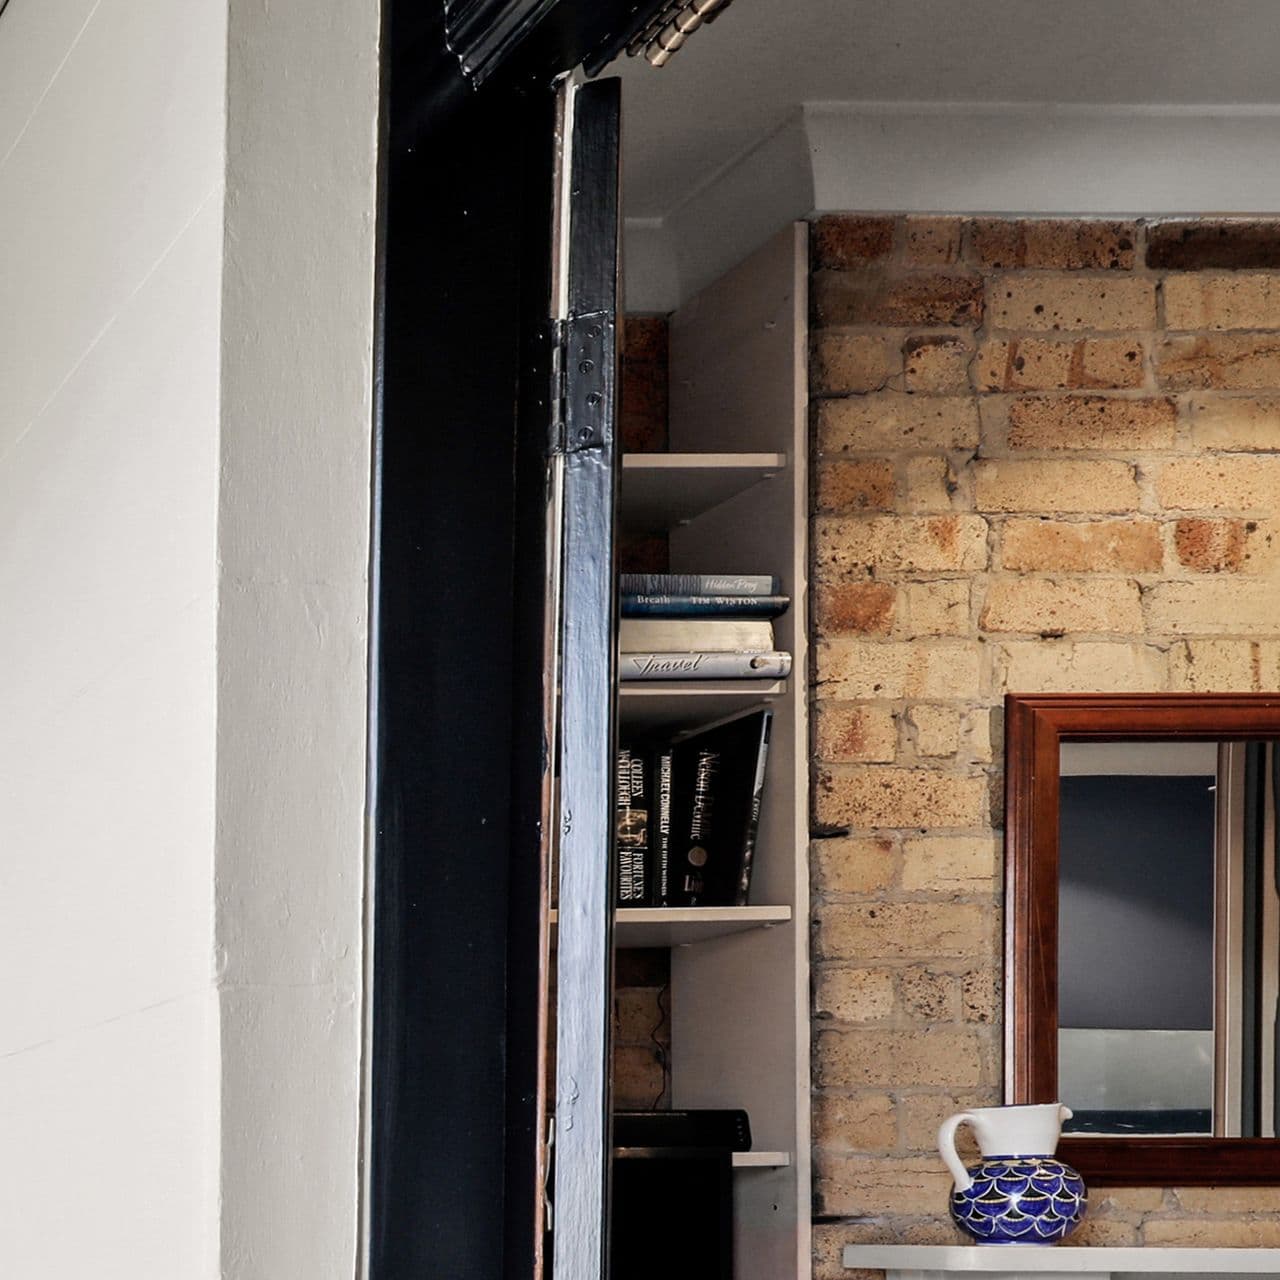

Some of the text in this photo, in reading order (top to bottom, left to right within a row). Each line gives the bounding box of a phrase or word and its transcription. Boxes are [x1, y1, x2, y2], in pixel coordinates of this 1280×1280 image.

[637, 594, 671, 605] Breath
[691, 597, 710, 605] TIM
[633, 654, 703, 677] Travel
[631, 758, 644, 797] COLLEEN
[661, 756, 671, 792] MICHAEL
[695, 751, 721, 792] Nelson
[660, 793, 670, 835] CONNELLY
[619, 851, 632, 900] FAVOURITES
